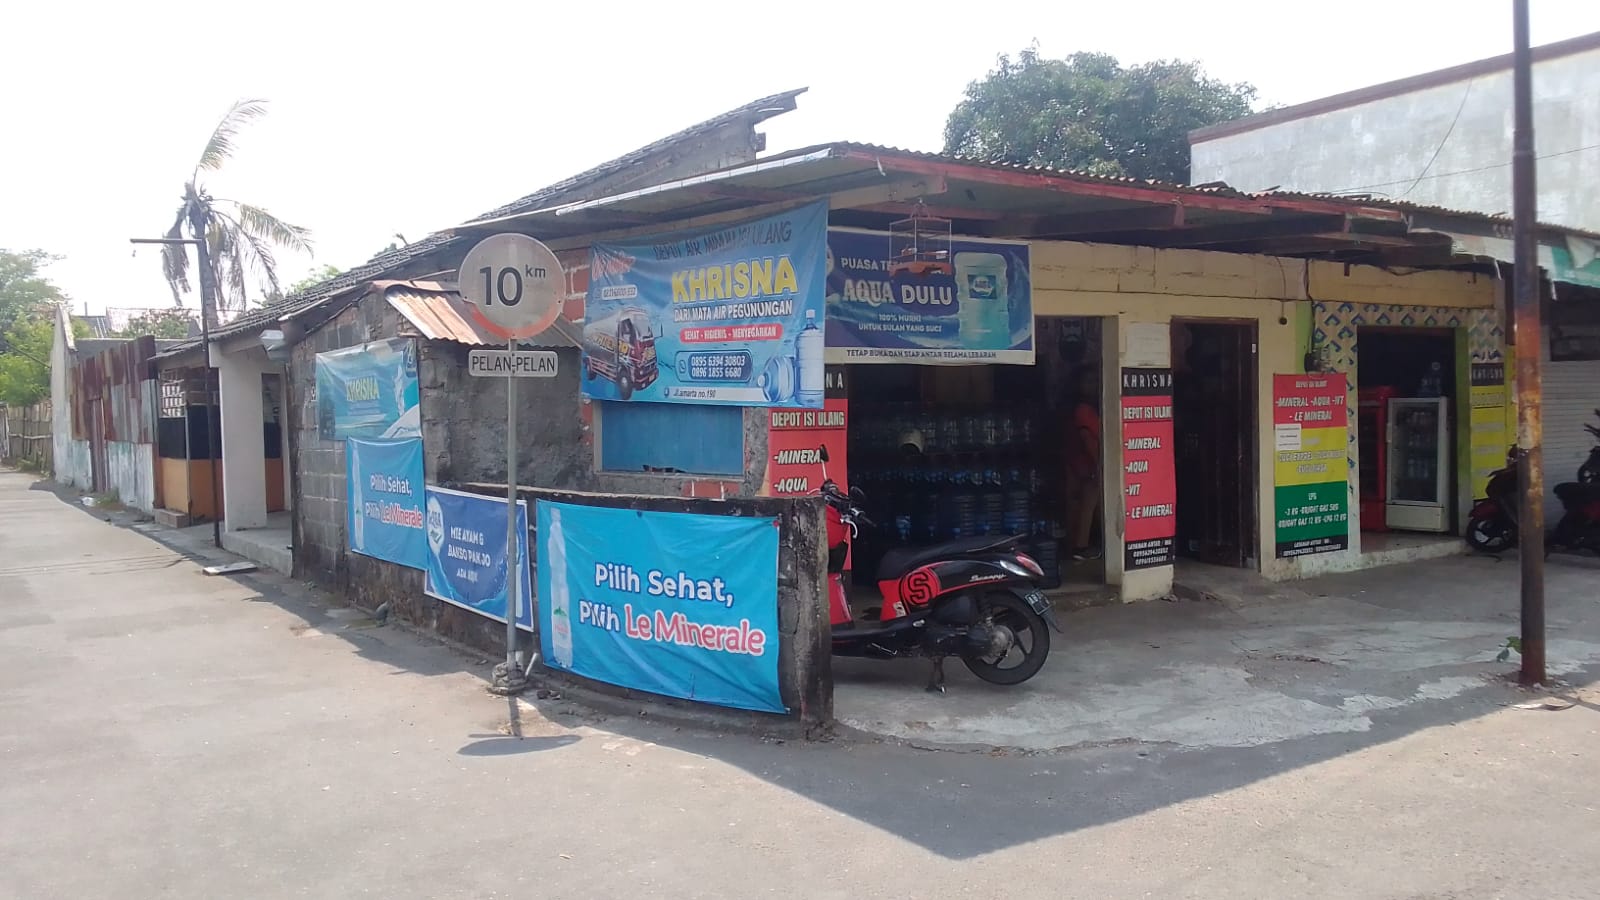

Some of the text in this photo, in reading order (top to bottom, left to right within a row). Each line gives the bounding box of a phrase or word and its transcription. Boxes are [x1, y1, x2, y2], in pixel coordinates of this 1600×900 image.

[752, 221, 792, 246] ULANG
[841, 257, 879, 271] PUASA
[479, 264, 546, 307] 10 km
[671, 256, 798, 304] KHRISNA
[843, 279, 952, 307] AQUA DULU
[674, 300, 793, 322] DARI MATA AIR PEGUNUNGAN
[684, 327, 777, 340] SEHAT HIGIENIS MENYEGARKAN
[858, 323, 942, 333] UNTUK BULAN YANG SUCI
[691, 356, 707, 366] 0895
[847, 350, 869, 358] TETAP
[472, 356, 555, 373] PELAN-PELAN
[691, 367, 707, 377] 0896
[1123, 374, 1172, 388] KHRISNA
[772, 411, 845, 427] DEPOT ISI ULANG
[1123, 407, 1143, 419] DEPOT
[1145, 406, 1153, 418] ISI
[774, 449, 821, 464] -MINERA
[387, 475, 413, 497] Sehat,
[390, 502, 423, 529] Minerale
[1131, 503, 1173, 519] LE MINERAL
[450, 525, 461, 540] MIE
[462, 529, 478, 545] AYAM
[447, 544, 491, 567] BAKSO PAK JO
[594, 562, 734, 607] Pilih Sehat,
[578, 600, 766, 656] Pilih Le Minerale
